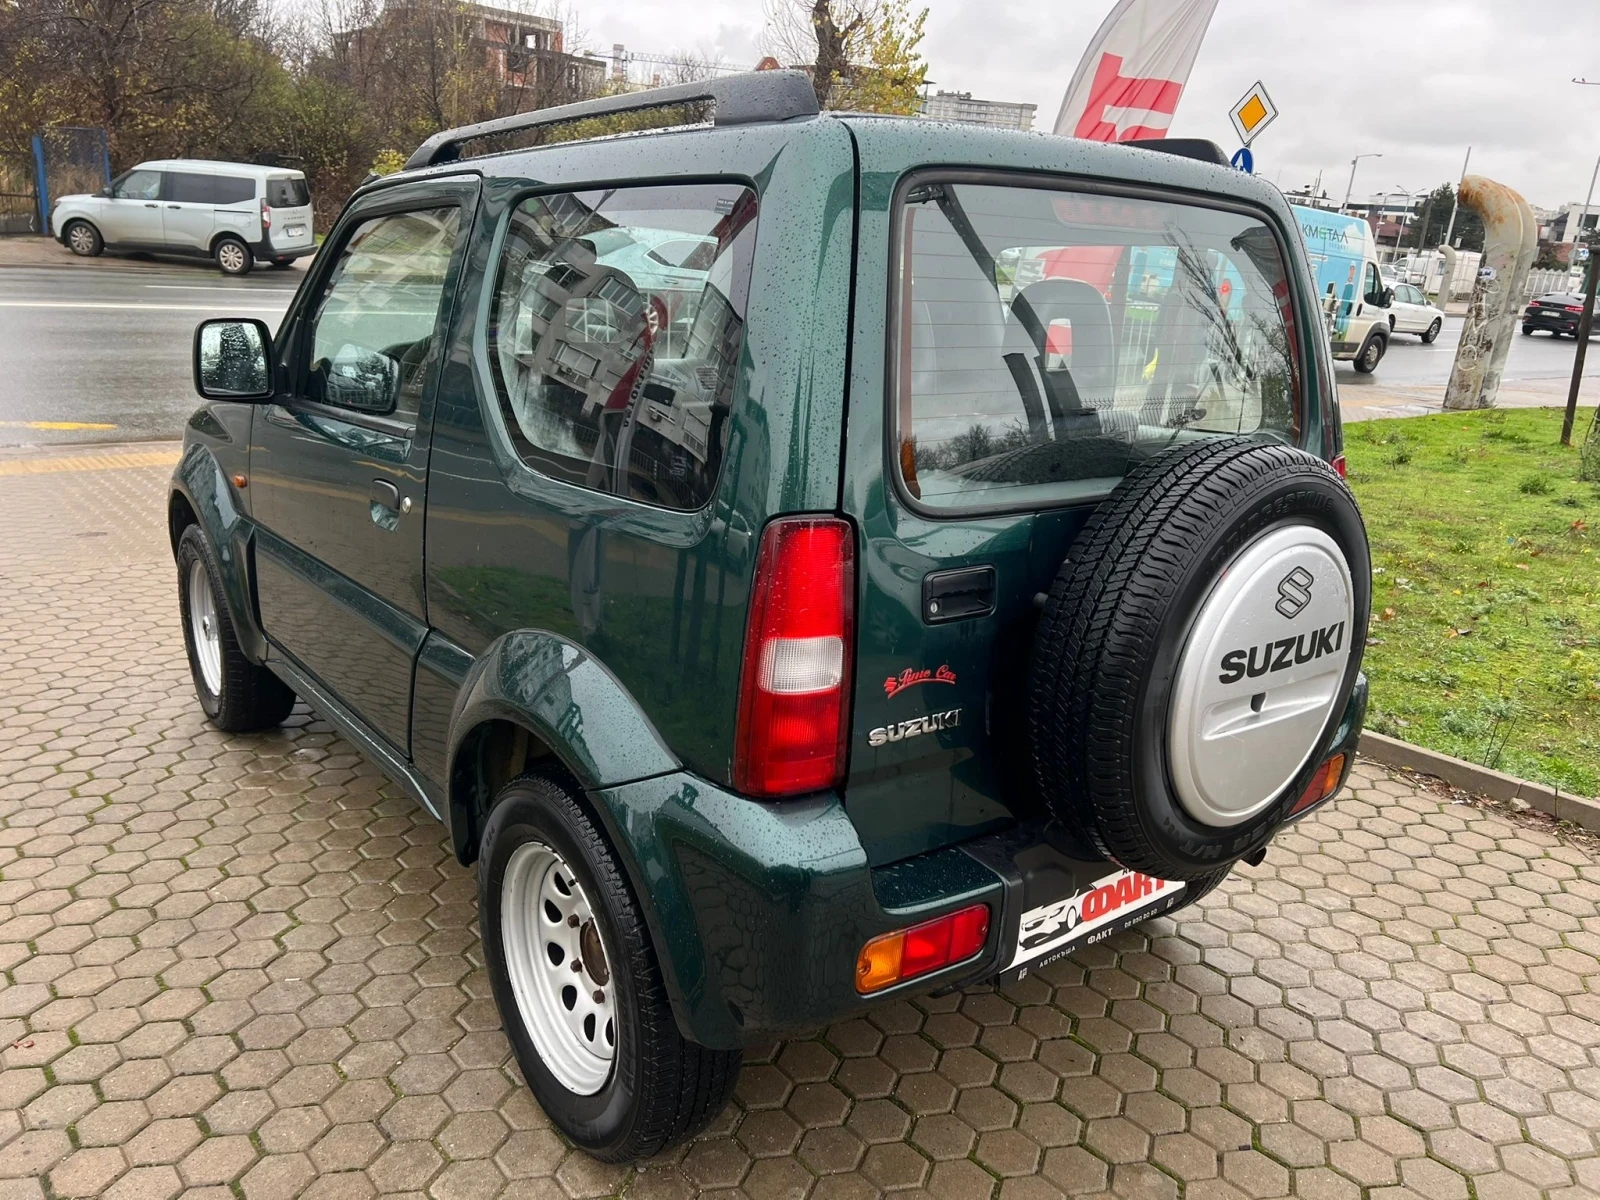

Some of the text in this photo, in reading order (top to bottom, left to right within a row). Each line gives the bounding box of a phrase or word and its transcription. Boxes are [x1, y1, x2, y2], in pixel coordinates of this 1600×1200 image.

[1219, 621, 1345, 684] SUZUKI
[868, 708, 962, 747] SUZUKI
[1087, 927, 1113, 944] ФАКТ
